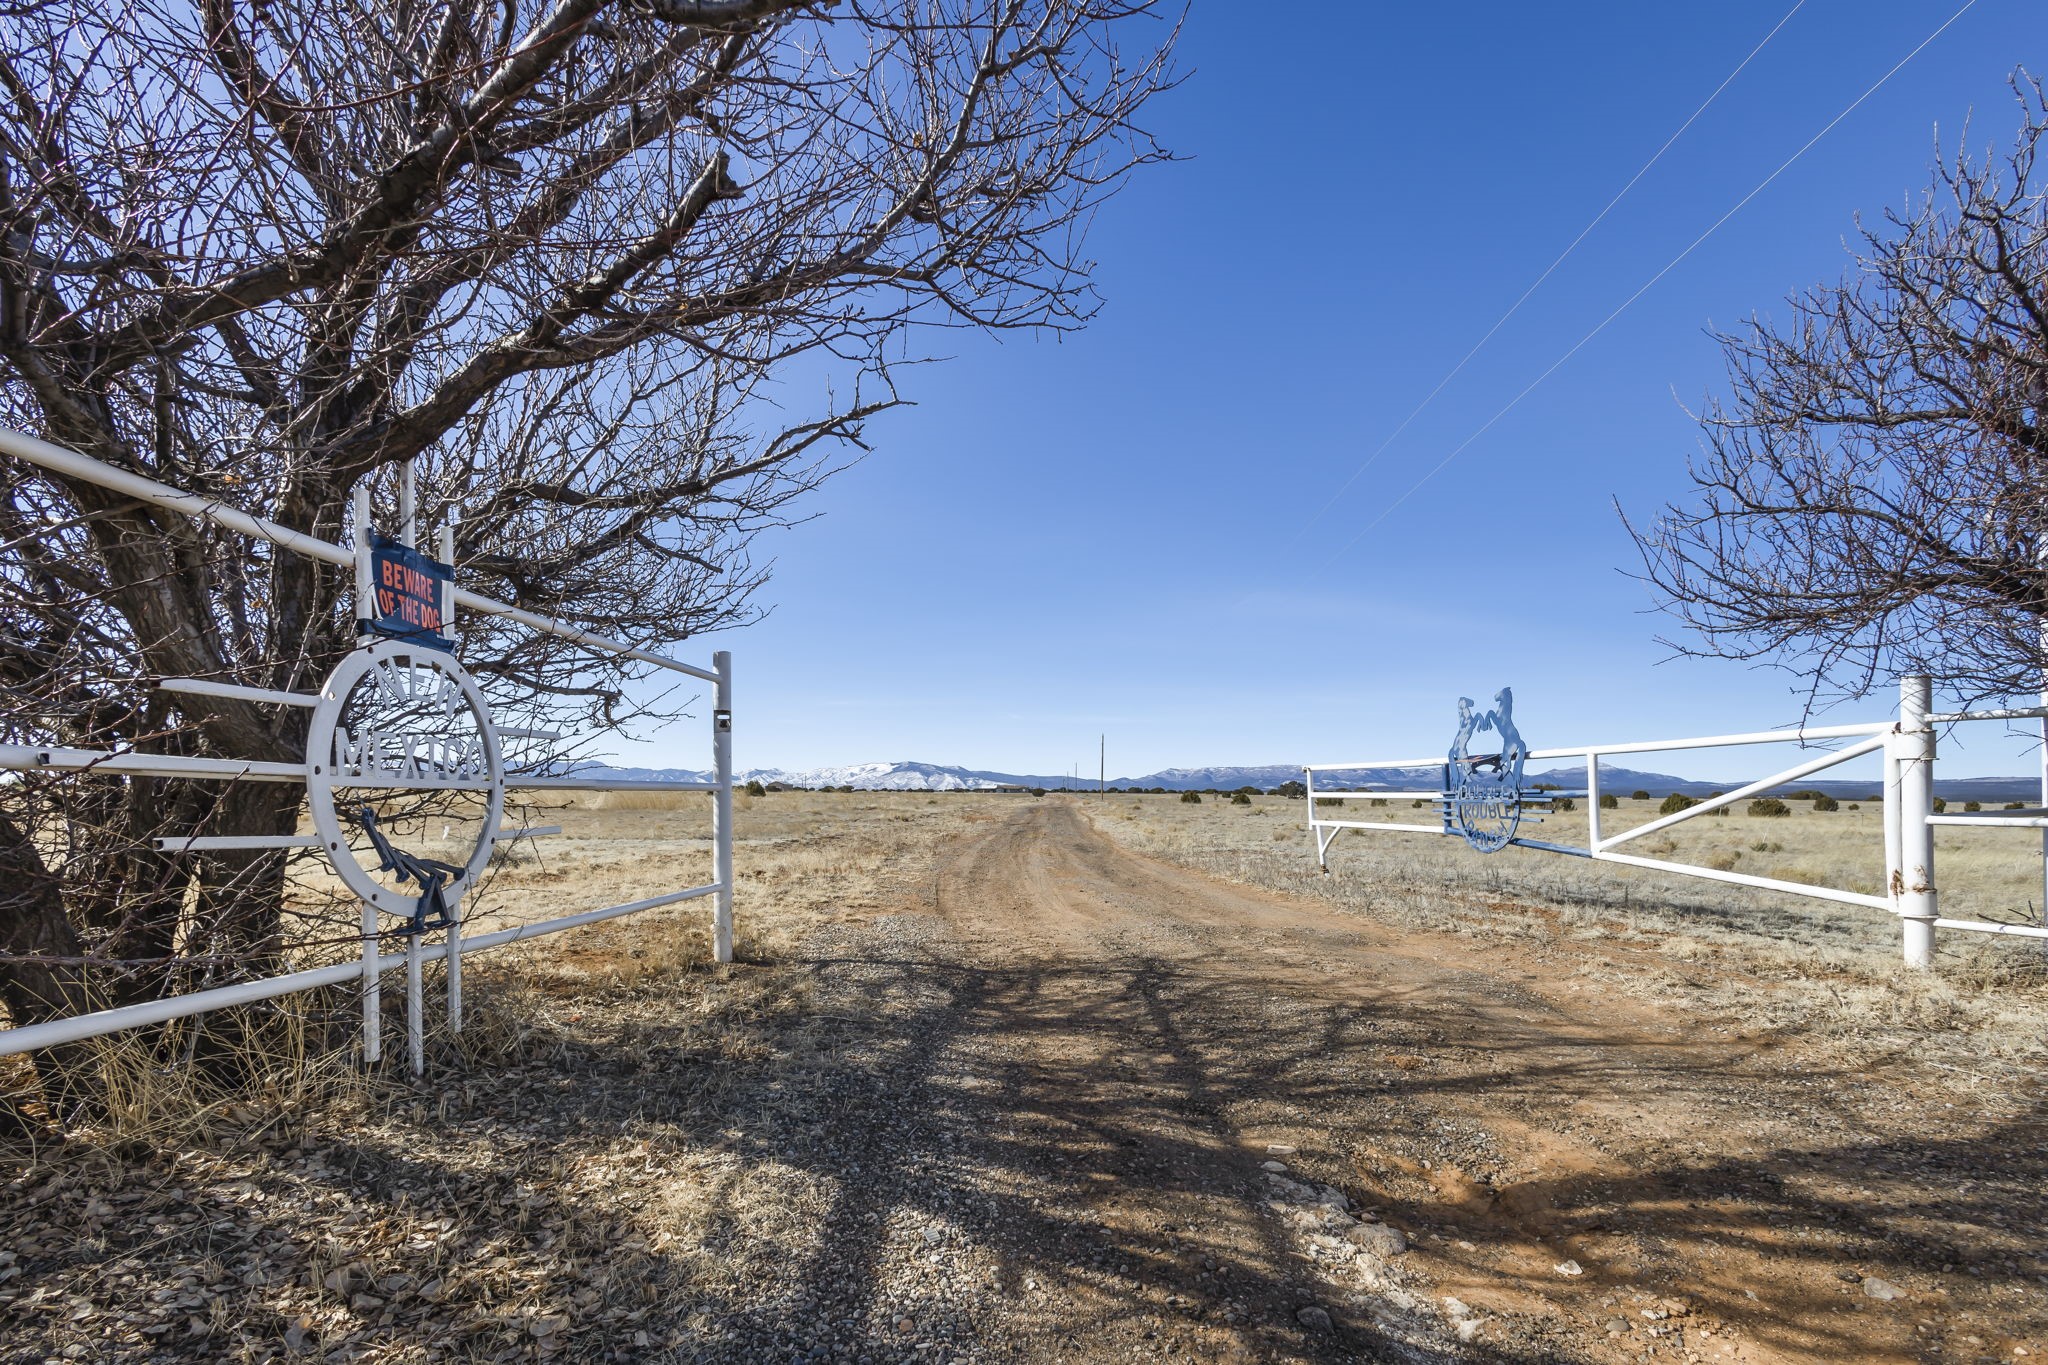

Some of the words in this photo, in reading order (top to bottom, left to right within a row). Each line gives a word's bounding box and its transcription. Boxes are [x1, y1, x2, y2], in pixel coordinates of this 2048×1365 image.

[382, 560, 434, 604] BEWARE
[379, 588, 395, 617] OF
[397, 594, 419, 626] THE
[420, 603, 441, 633] DOG
[371, 655, 463, 717] NEW
[335, 726, 484, 780] MEXICO
